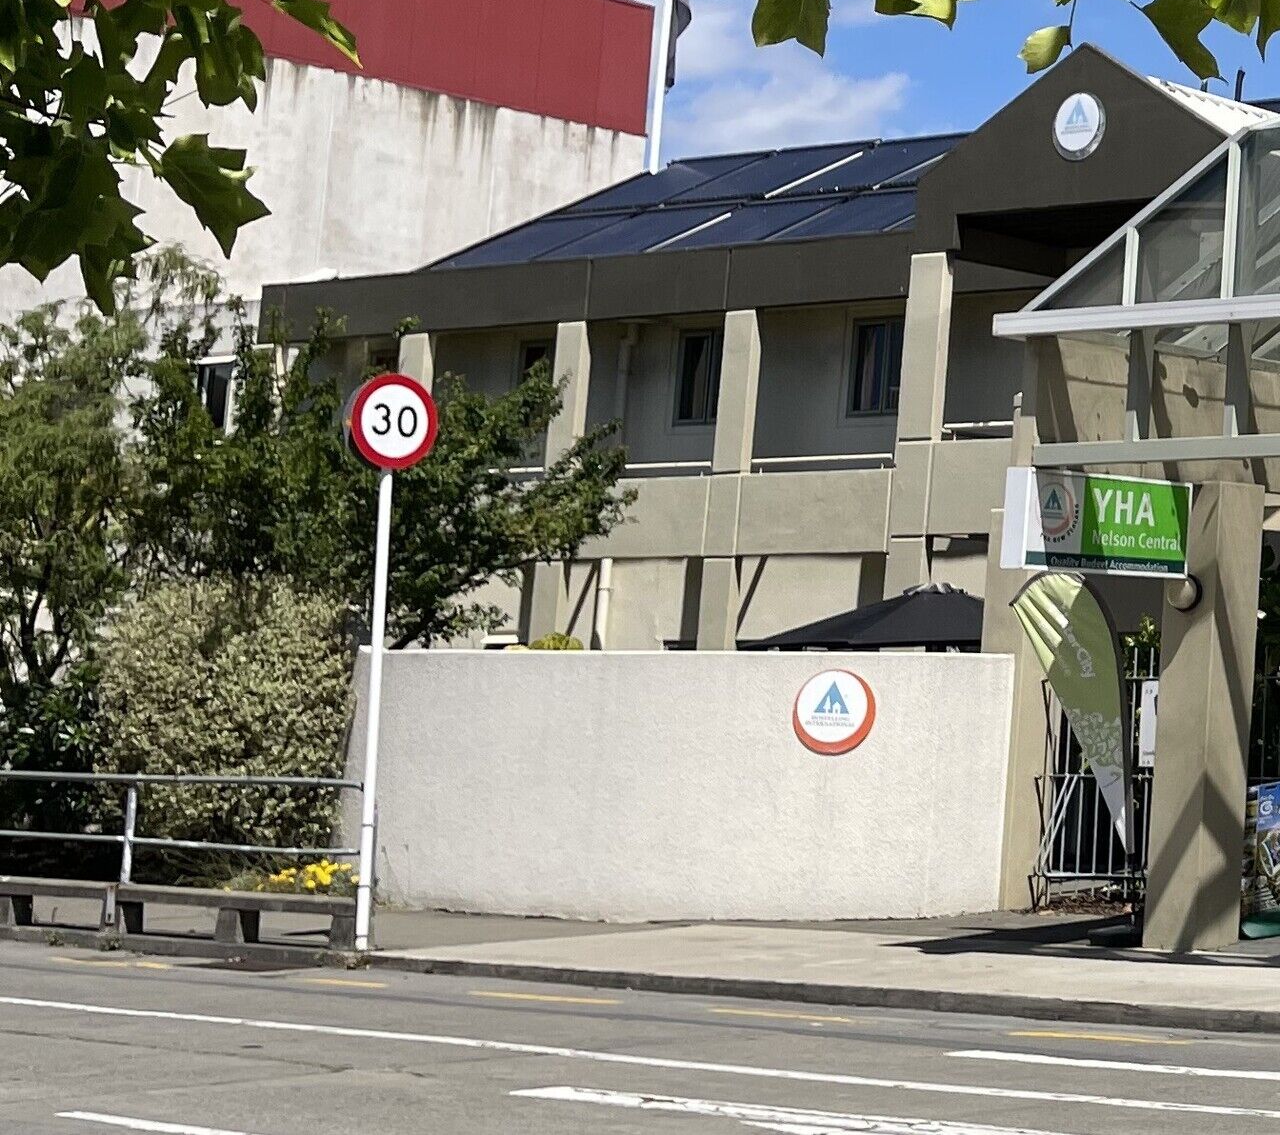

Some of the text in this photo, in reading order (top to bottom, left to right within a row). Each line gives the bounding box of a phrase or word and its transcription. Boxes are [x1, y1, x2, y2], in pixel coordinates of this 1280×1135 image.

[371, 402, 418, 438] 30
[1093, 487, 1156, 527] YHA
[1091, 529, 1181, 552] Nelson Central
[1109, 559, 1169, 572] Accommodation
